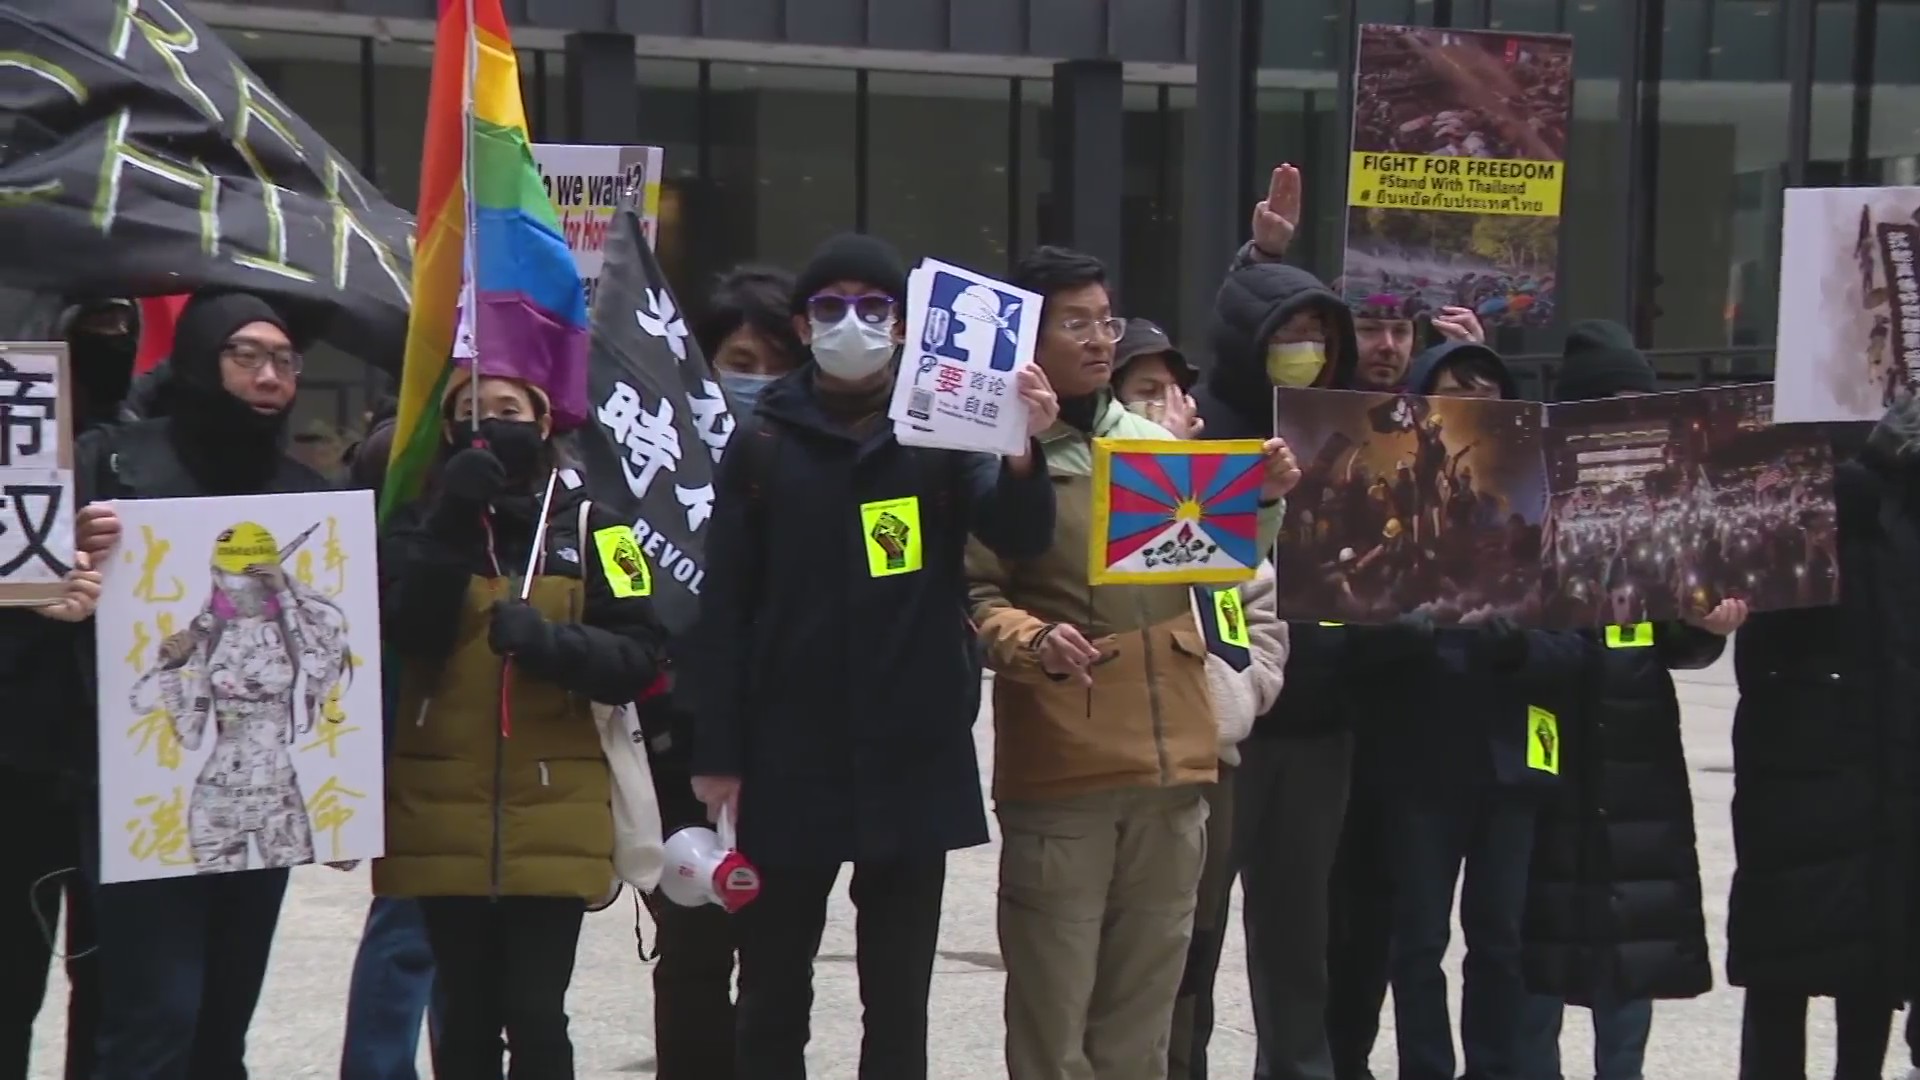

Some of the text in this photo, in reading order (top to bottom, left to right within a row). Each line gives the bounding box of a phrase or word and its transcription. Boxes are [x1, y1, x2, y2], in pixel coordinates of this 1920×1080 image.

[1364, 154, 1555, 180] FIGHT FOR FREEDOM
[557, 175, 583, 206] we
[1379, 174, 1526, 194] #Stand With Thailand
[935, 363, 1007, 397] 要 言论
[964, 395, 999, 419] 自由
[633, 517, 705, 596] REVOL
